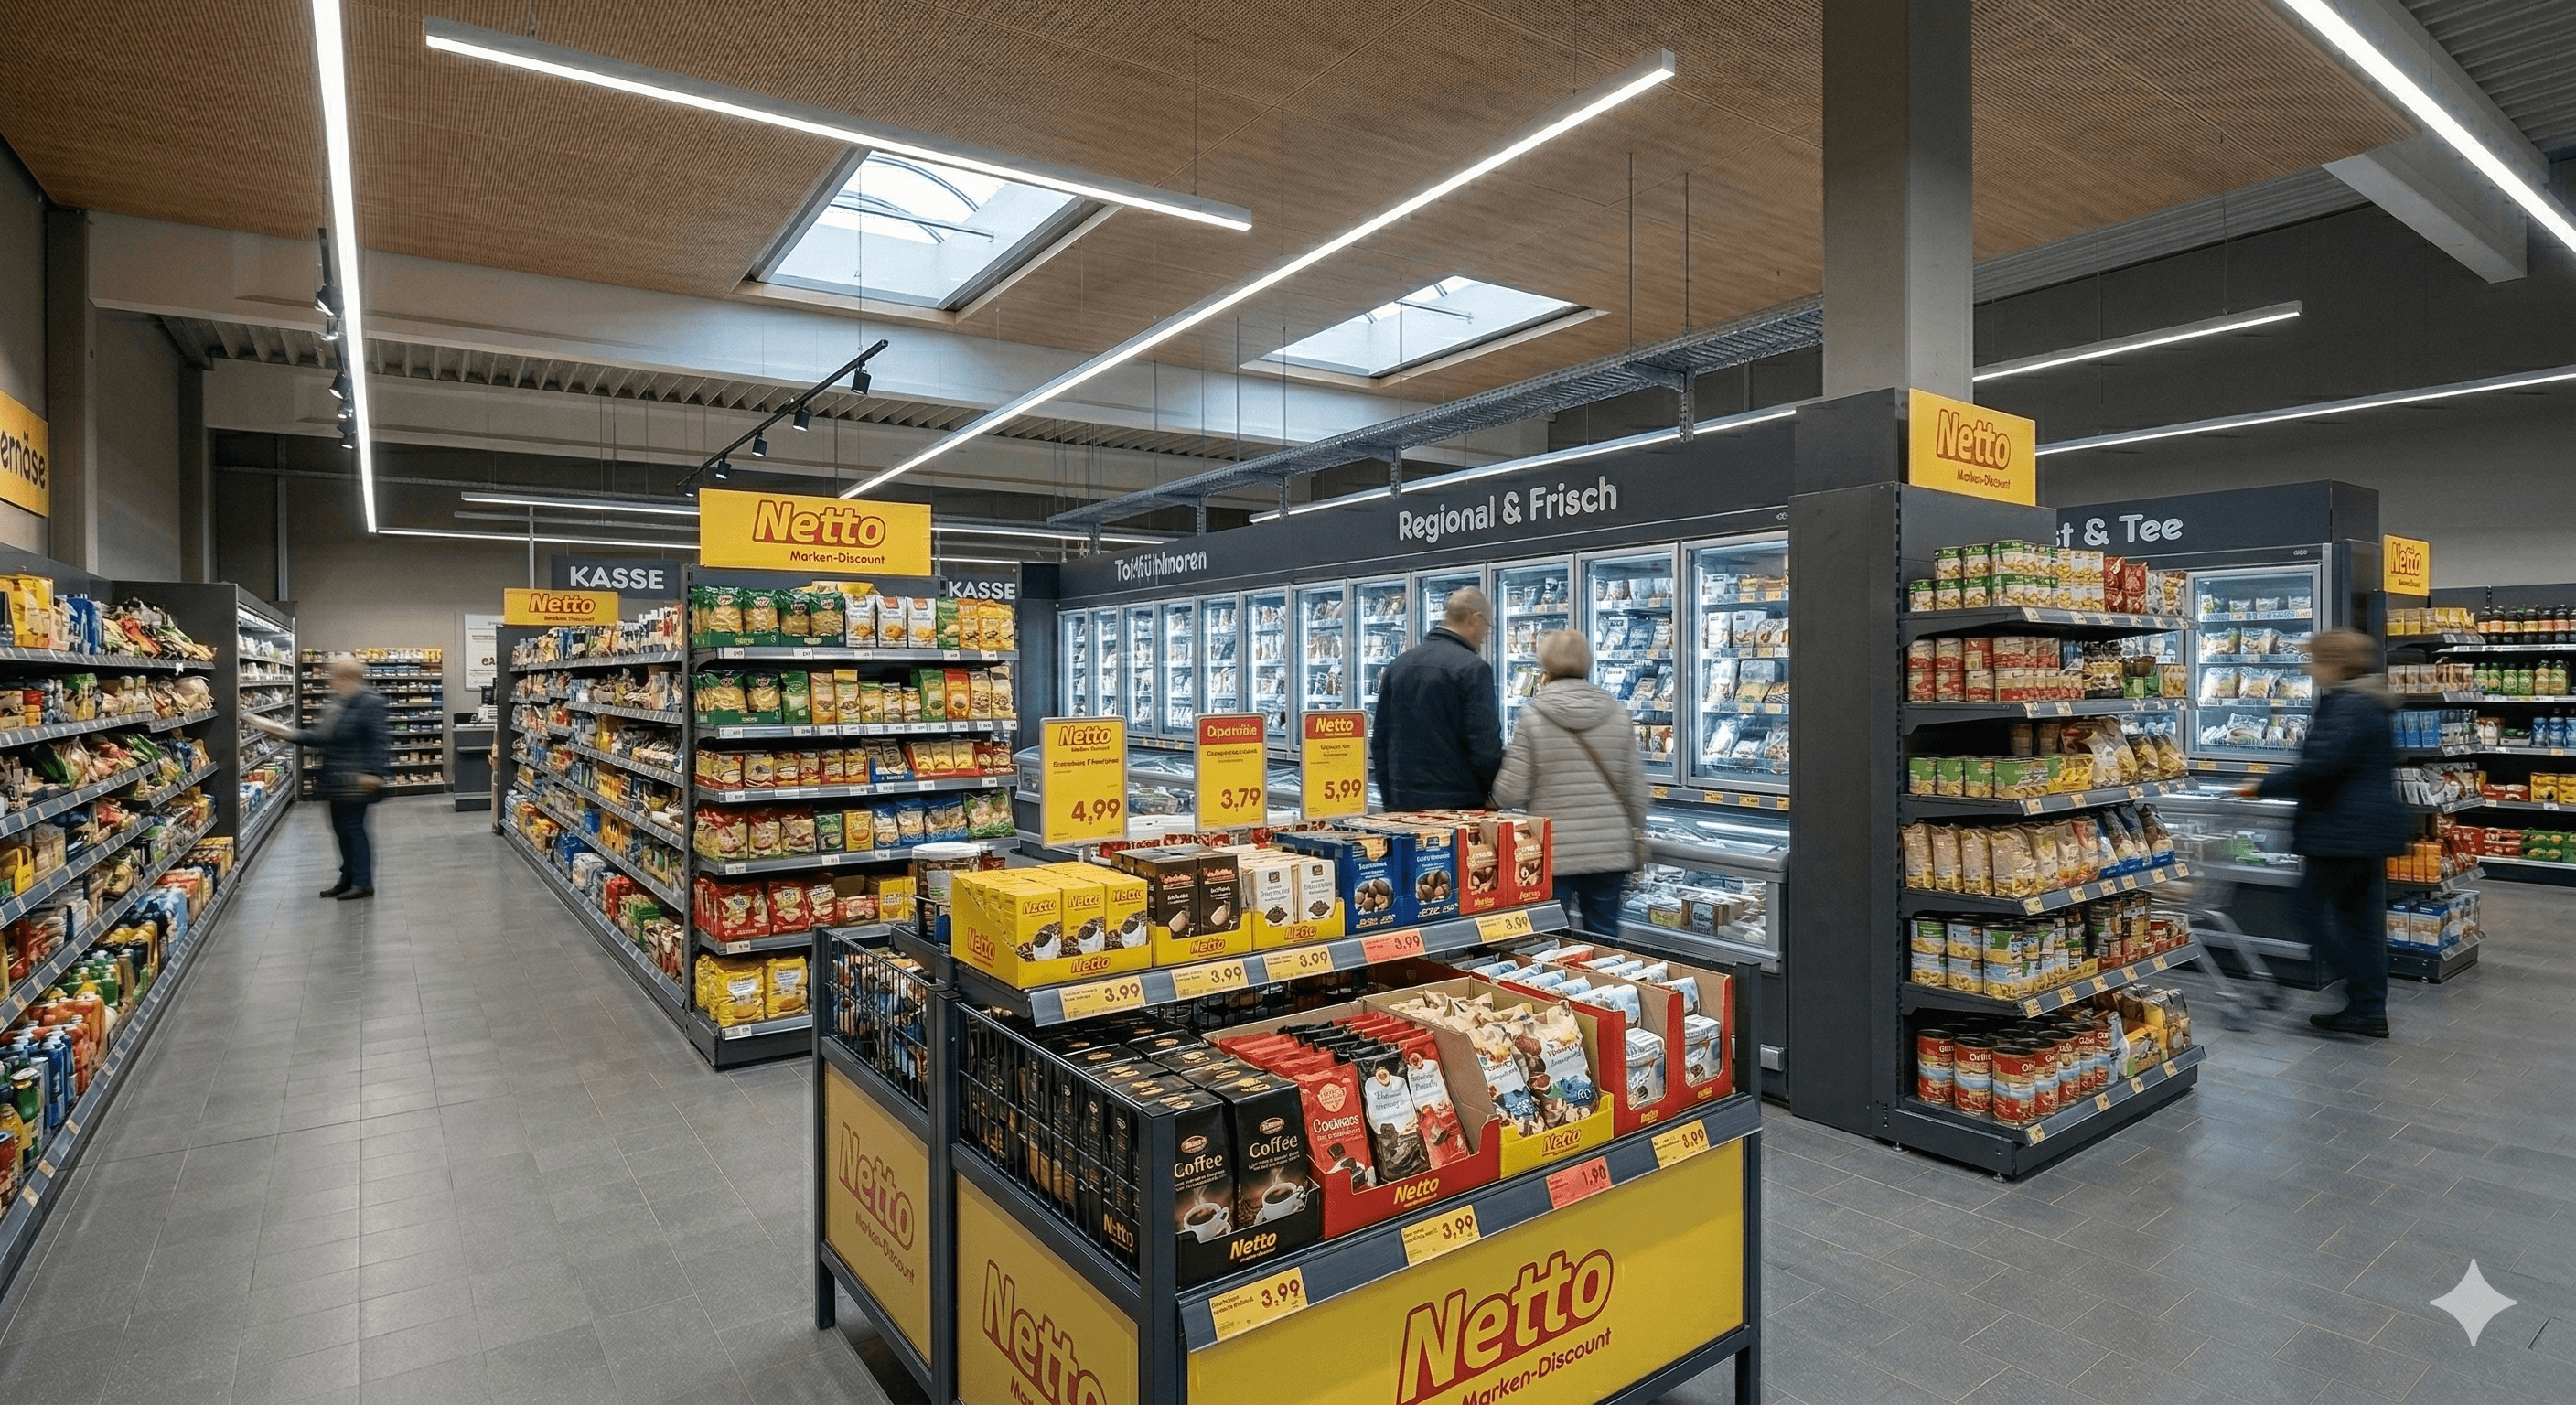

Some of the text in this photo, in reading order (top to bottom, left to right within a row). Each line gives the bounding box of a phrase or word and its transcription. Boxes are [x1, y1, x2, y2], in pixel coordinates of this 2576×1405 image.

[1936, 408, 2012, 471] Netto
[1399, 476, 1617, 543] Regional & Frisch
[752, 499, 887, 549] Netto
[2084, 518, 2110, 547] &
[2118, 514, 2184, 543] Tee
[789, 551, 886, 565] Marken-Discount
[570, 566, 664, 590] KASSE
[948, 581, 1016, 600] KASSE
[529, 594, 596, 614] Netto
[1058, 725, 1112, 746] Netto
[1315, 717, 1354, 733] Netto
[1220, 787, 1261, 813] 3,79
[1324, 778, 1362, 802] 5,99
[1071, 798, 1121, 825] 4,99
[1071, 956, 1111, 974] Netto
[1174, 1154, 1223, 1178] Coffee
[839, 1121, 914, 1251] Netto
[1393, 1177, 1440, 1205] Netto
[1229, 1232, 1277, 1260] Netto
[1396, 1249, 1615, 1405] Netto
[1462, 1326, 1612, 1405] Marken-Discount
